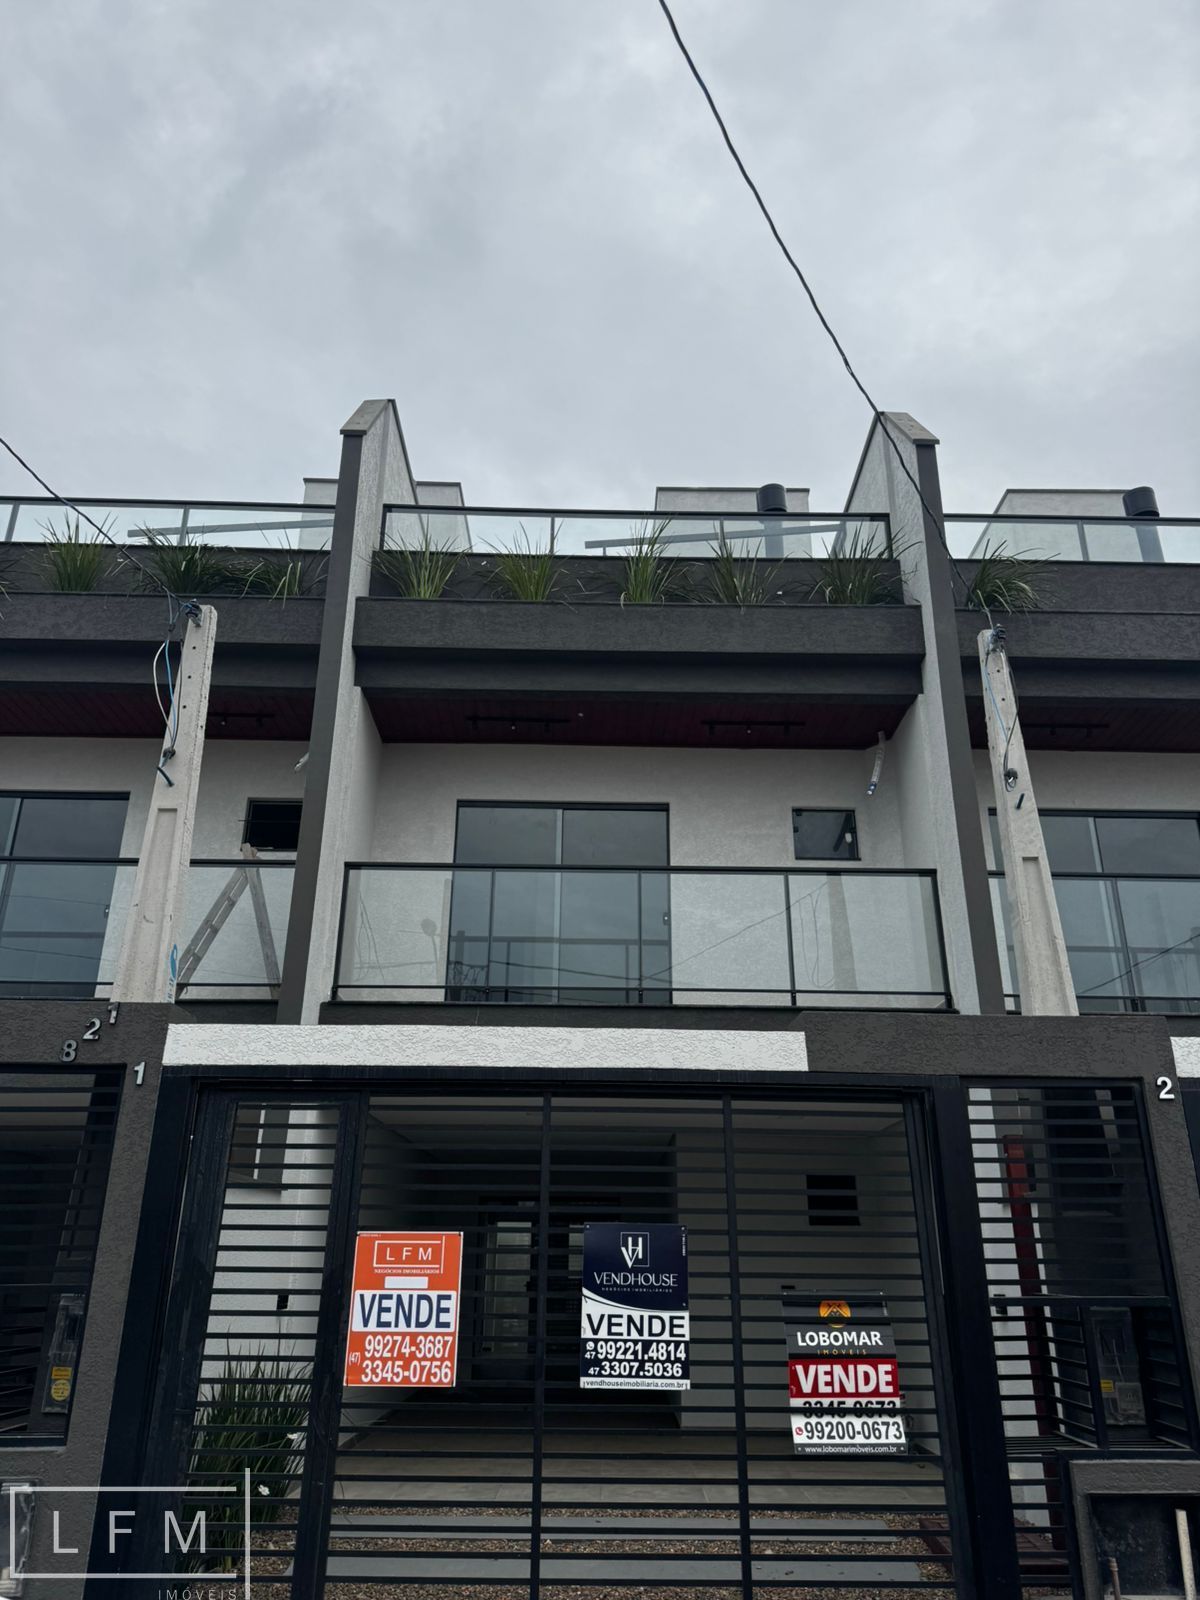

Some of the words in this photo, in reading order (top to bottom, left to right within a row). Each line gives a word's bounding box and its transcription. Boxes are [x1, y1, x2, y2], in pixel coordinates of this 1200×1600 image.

[134, 1061, 146, 1085] 1
[1156, 1076, 1175, 1099] 2
[593, 1271, 679, 1286] VENDHOUSE
[359, 1293, 452, 1328] VENDE
[586, 1314, 686, 1338] VENDE
[364, 1335, 453, 1358] 99274-3687
[797, 1332, 883, 1346] LOBOMAR
[348, 1351, 361, 1365] (47)
[584, 1351, 596, 1359] 47
[597, 1341, 687, 1361] 99221.4814
[361, 1360, 452, 1383] 3345-0756
[588, 1367, 600, 1376] 47
[601, 1361, 683, 1377] 3307.5036
[795, 1364, 894, 1394] VENDE
[586, 1380, 684, 1389] vendhouseimobiliaria.com.br
[803, 1401, 897, 1418] 33450673
[804, 1422, 903, 1440] 99200-0673
